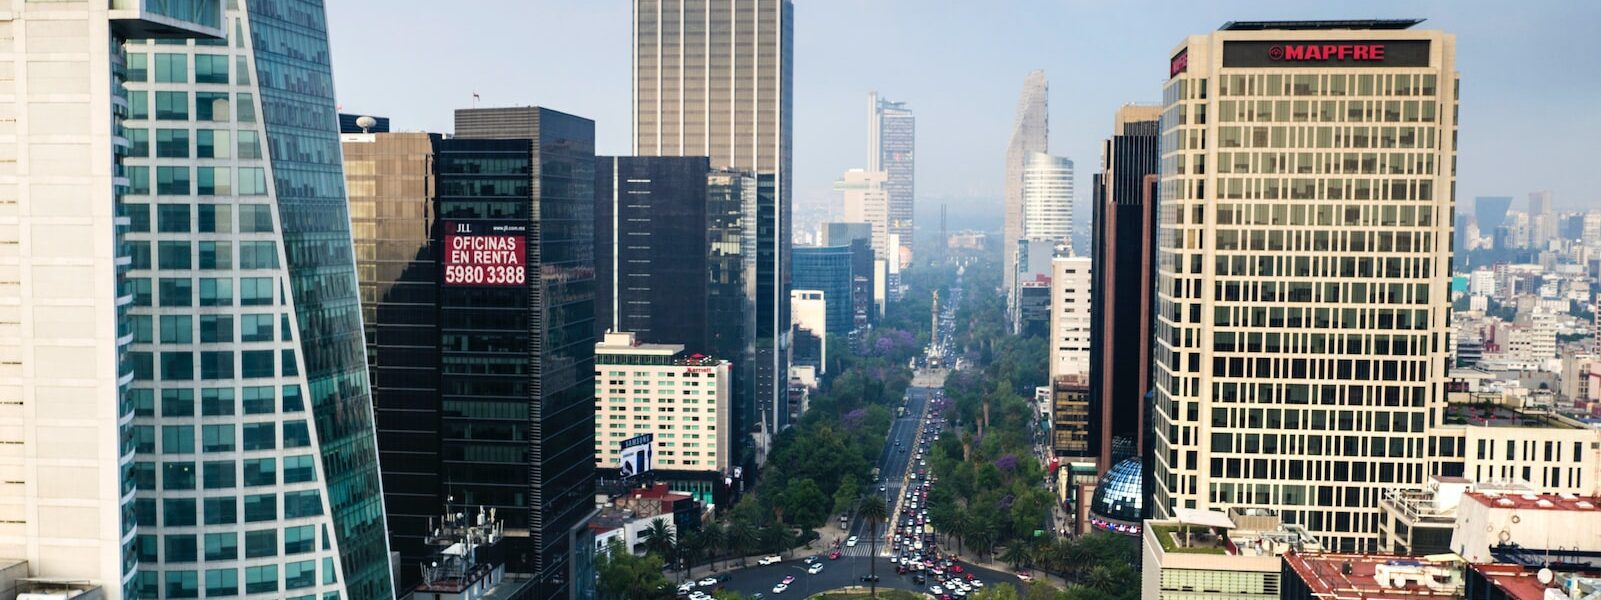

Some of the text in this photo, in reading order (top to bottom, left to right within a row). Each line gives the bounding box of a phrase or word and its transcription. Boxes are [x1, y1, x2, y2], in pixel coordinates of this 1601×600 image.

[1285, 44, 1385, 60] MAPFRE
[457, 223, 472, 233] JLL
[453, 236, 516, 250] OFICINAS
[451, 250, 518, 264] EN RENTA
[446, 265, 525, 284] 5980 3388
[625, 434, 651, 448] SAMSUNG
